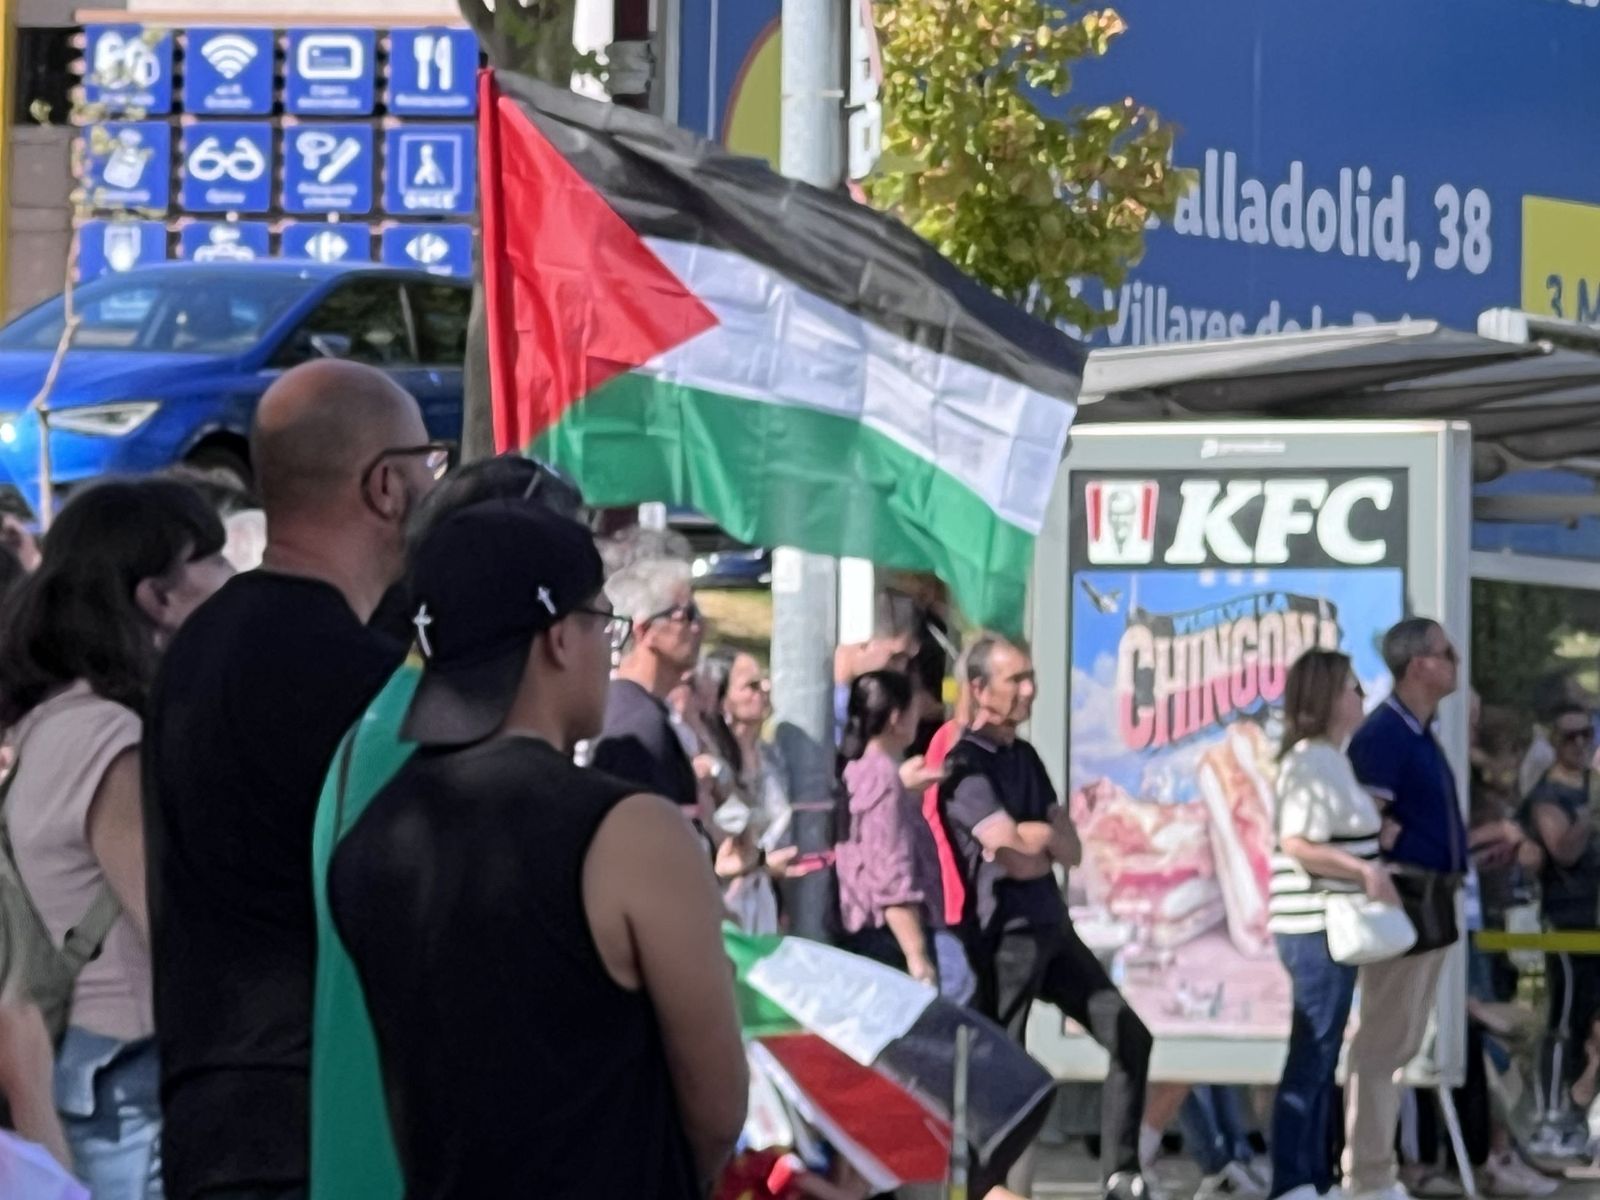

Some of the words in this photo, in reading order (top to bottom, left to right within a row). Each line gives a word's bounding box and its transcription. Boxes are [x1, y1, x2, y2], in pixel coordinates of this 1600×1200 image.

[1144, 147, 1420, 281] alladolid,
[1434, 183, 1491, 275] 38
[1164, 476, 1394, 564] KFC
